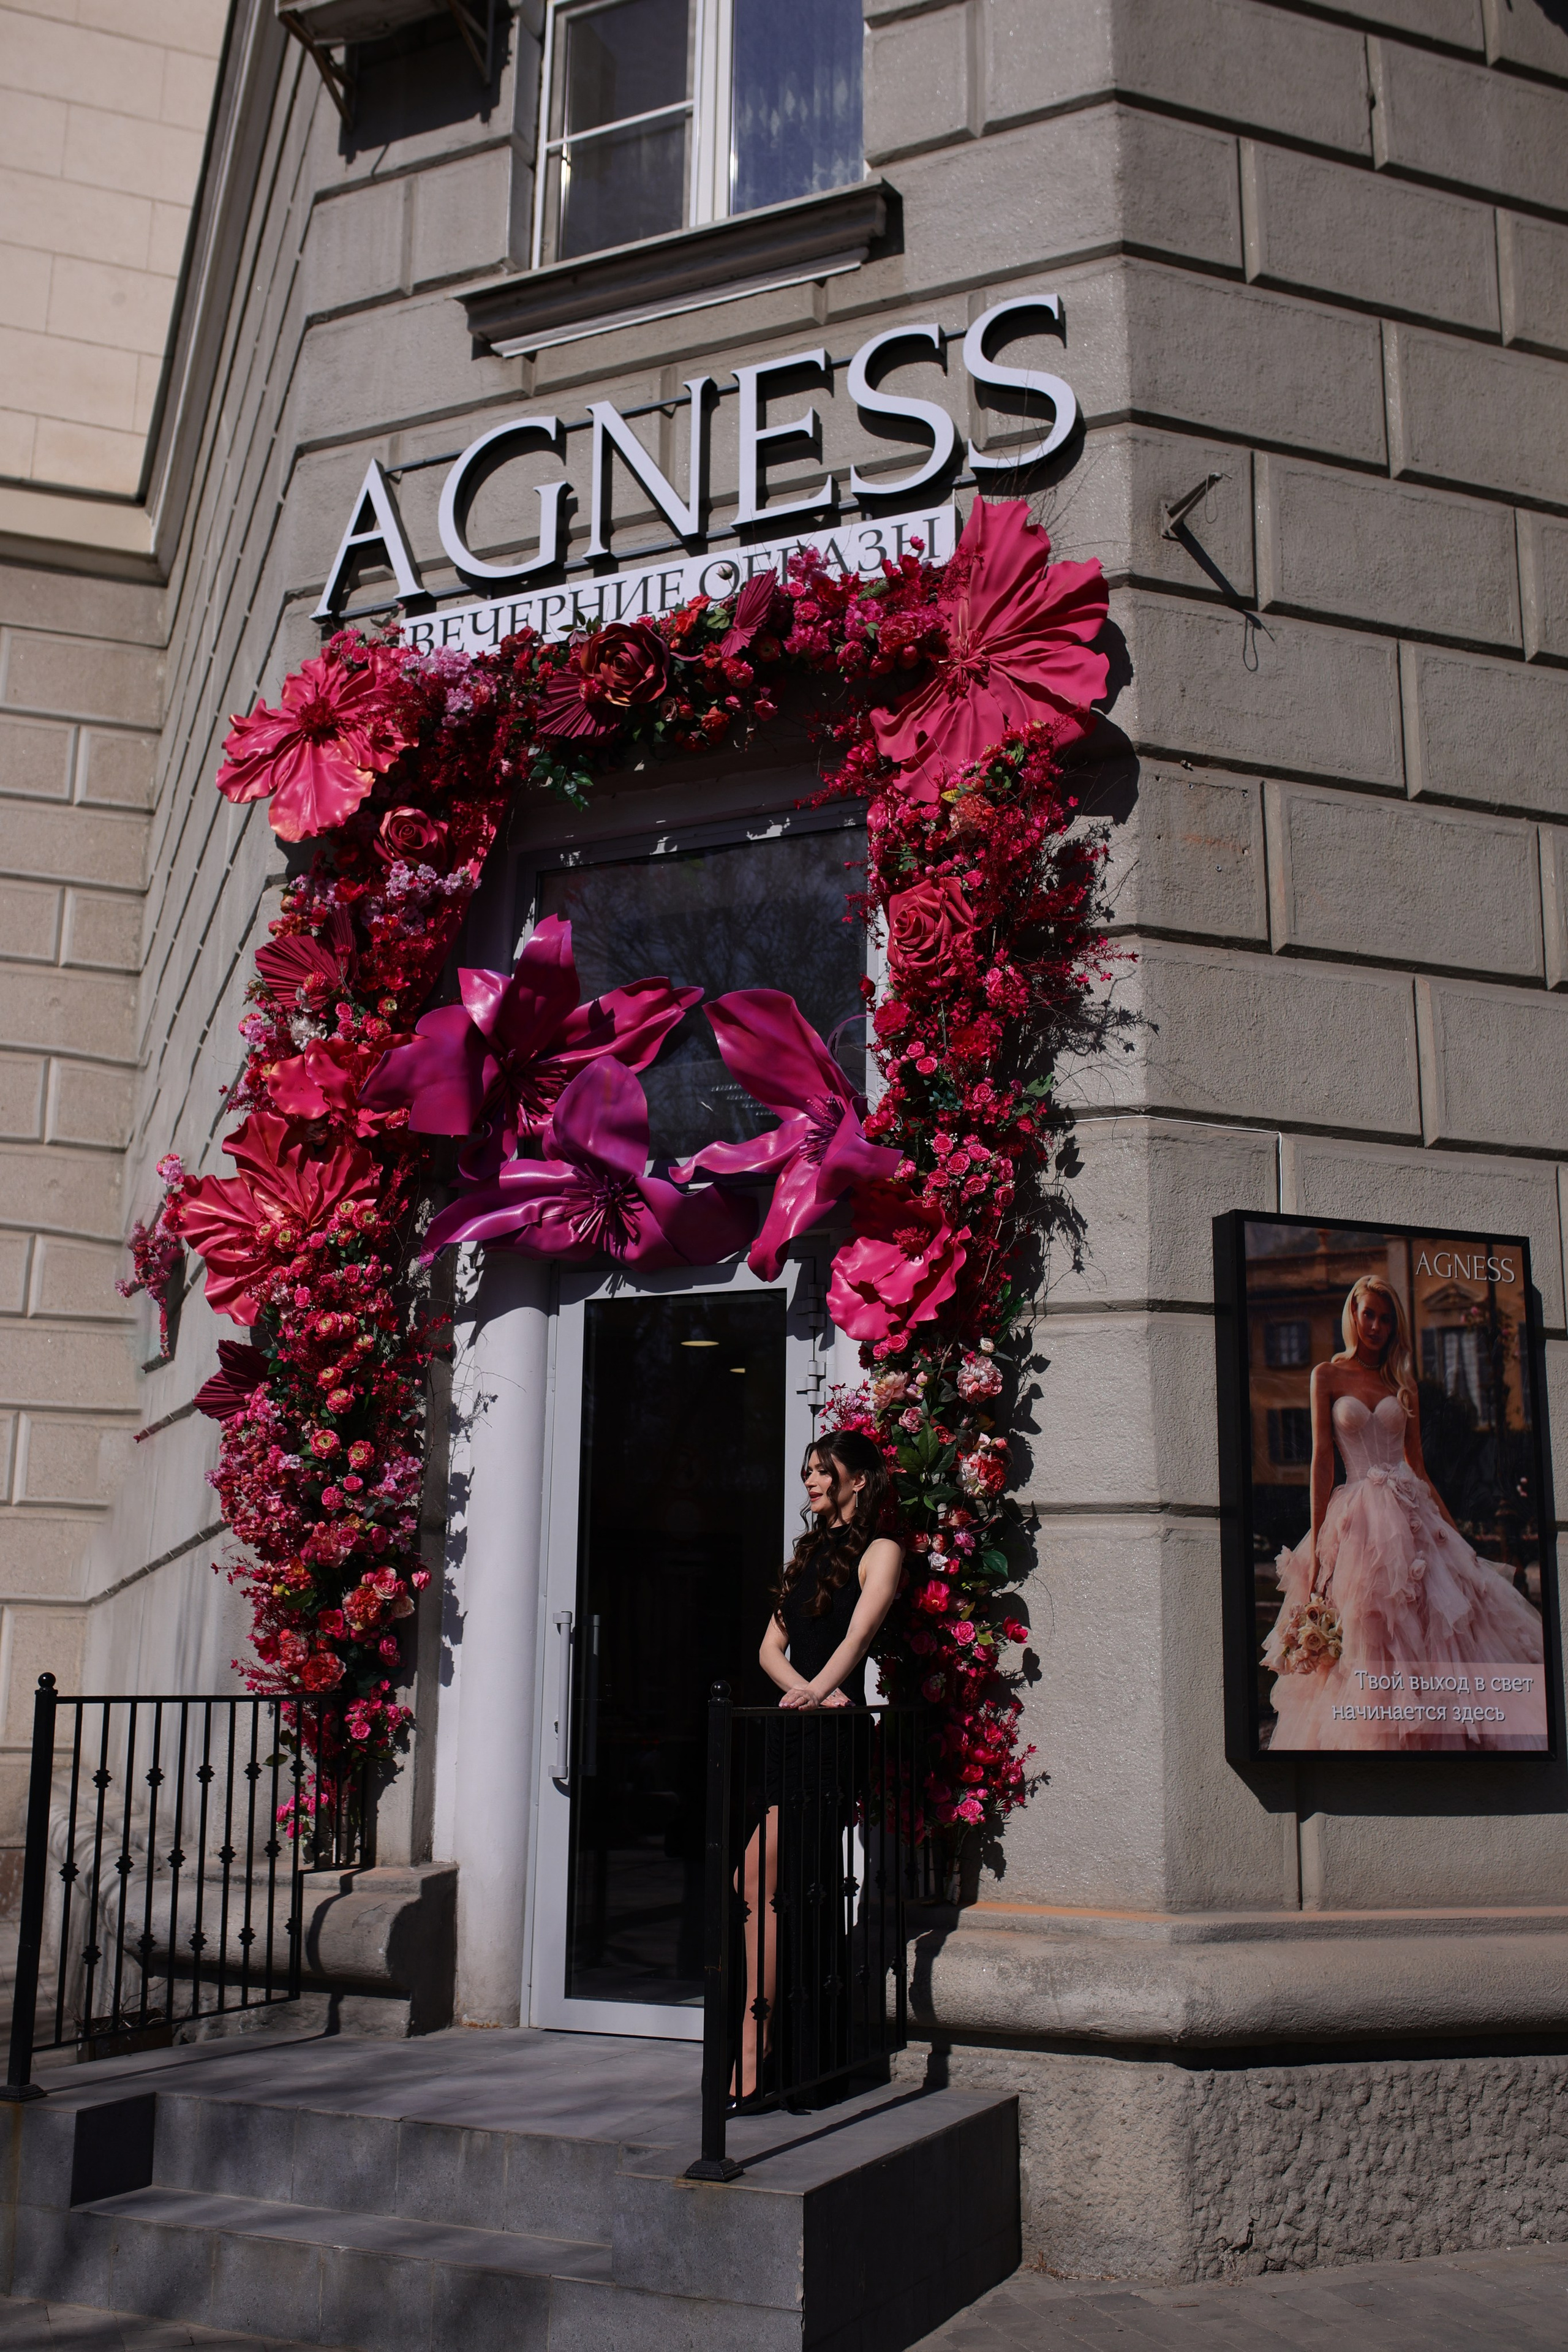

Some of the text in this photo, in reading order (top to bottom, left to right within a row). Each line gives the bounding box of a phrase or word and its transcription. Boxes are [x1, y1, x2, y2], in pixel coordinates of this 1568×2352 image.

[309, 293, 1080, 620] AGNESS
[409, 568, 685, 659] ВЕЧЕРНИЕ
[1415, 1251, 1516, 1283] AGNESS
[1354, 1670, 1534, 1694] Твой выход в свет
[1332, 1705, 1506, 1724] начинается здесь
